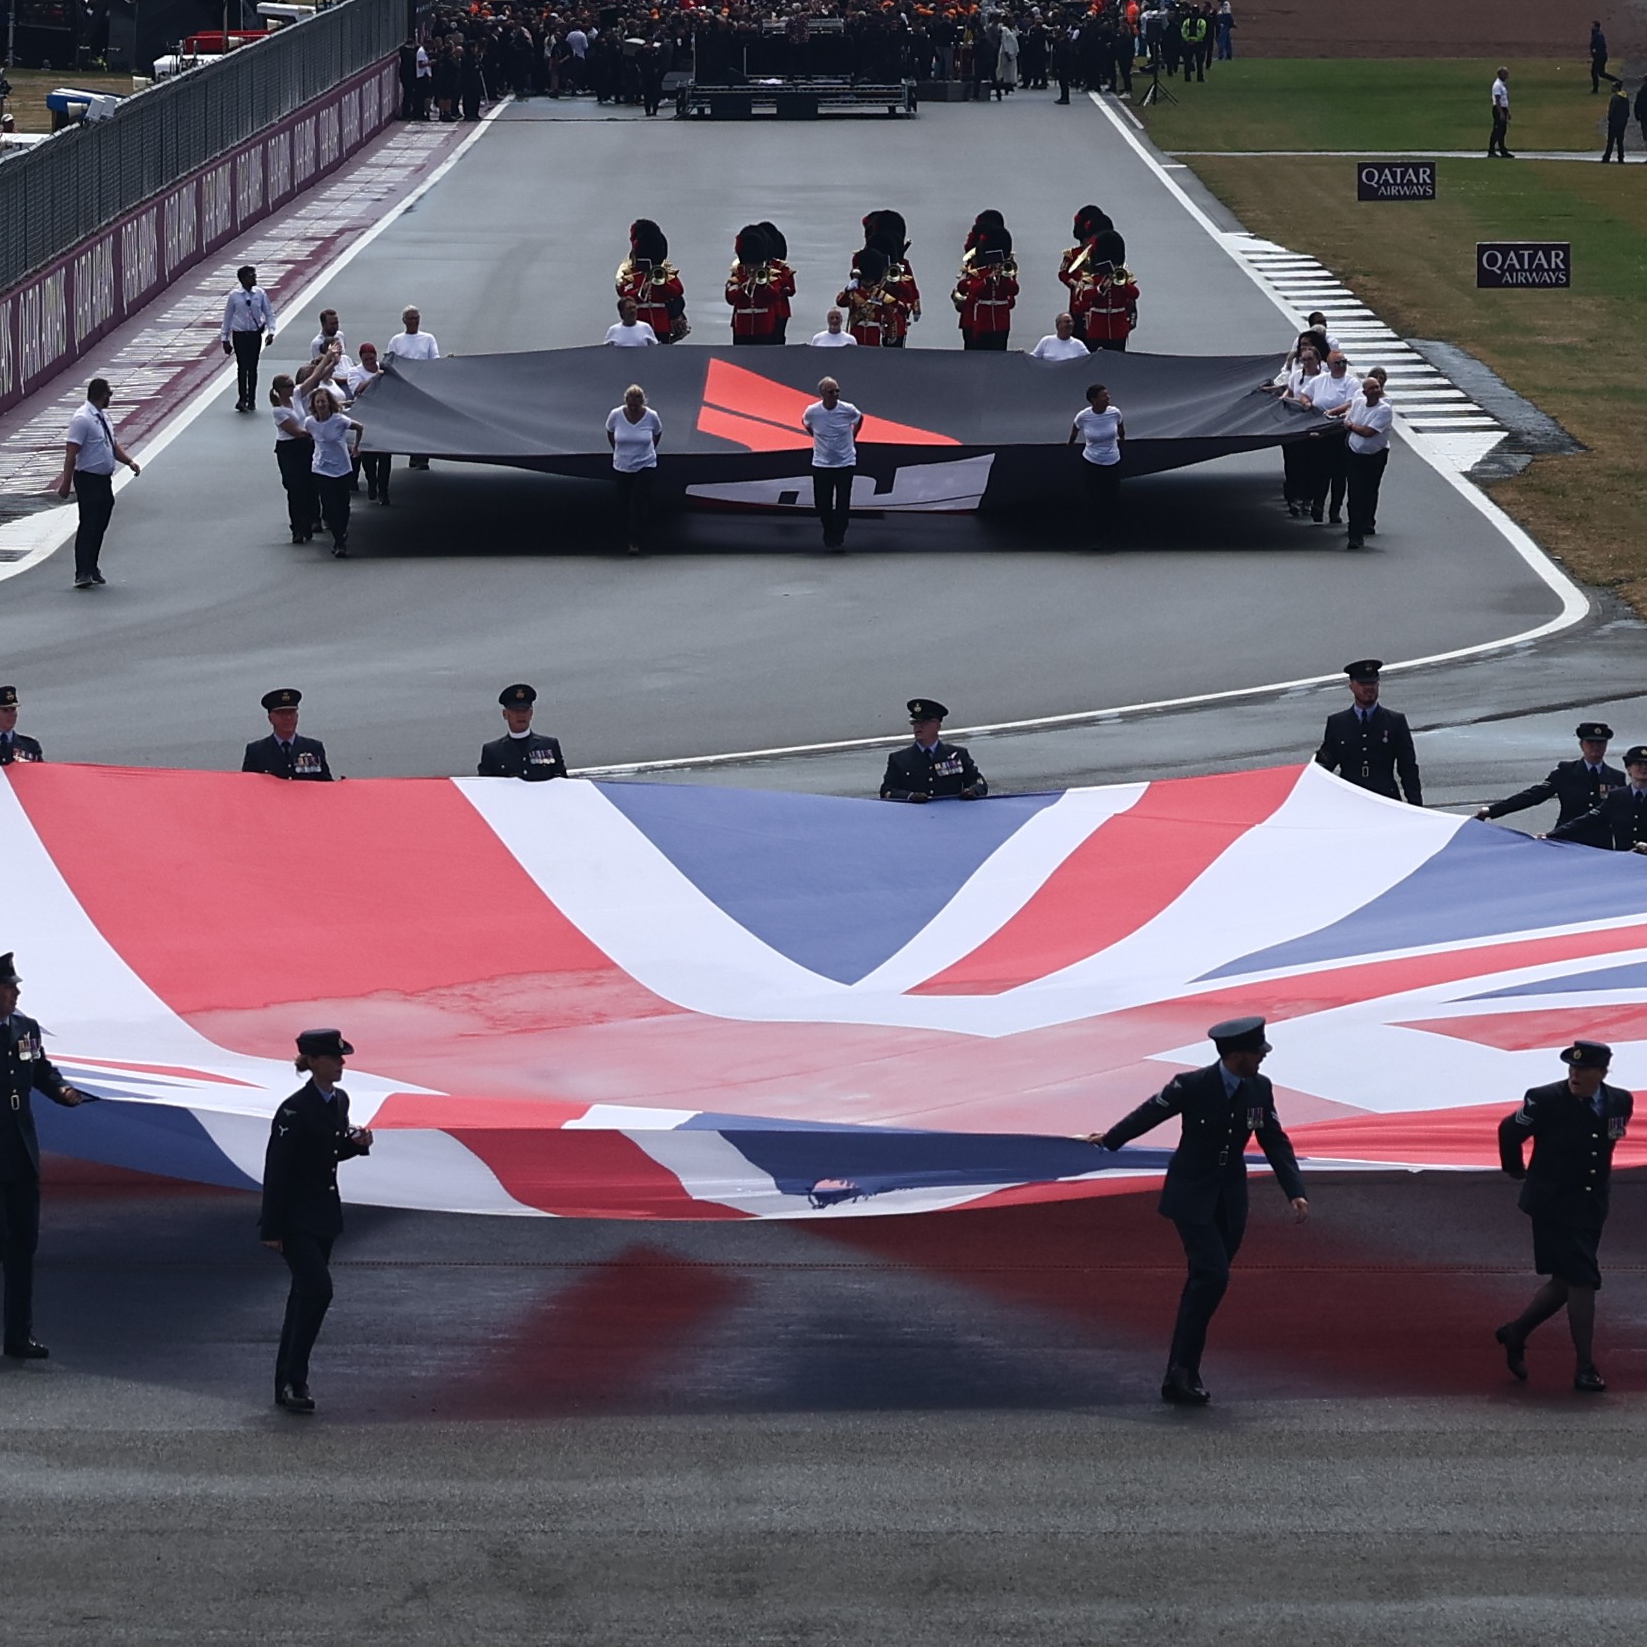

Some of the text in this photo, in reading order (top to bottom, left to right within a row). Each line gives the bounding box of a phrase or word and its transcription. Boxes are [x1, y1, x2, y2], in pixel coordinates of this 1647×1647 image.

[1362, 167, 1431, 187] QATAR
[1378, 185, 1433, 197] AIRWAYS
[1482, 250, 1565, 274] QATAR
[1502, 271, 1566, 284] AIRWAYS
